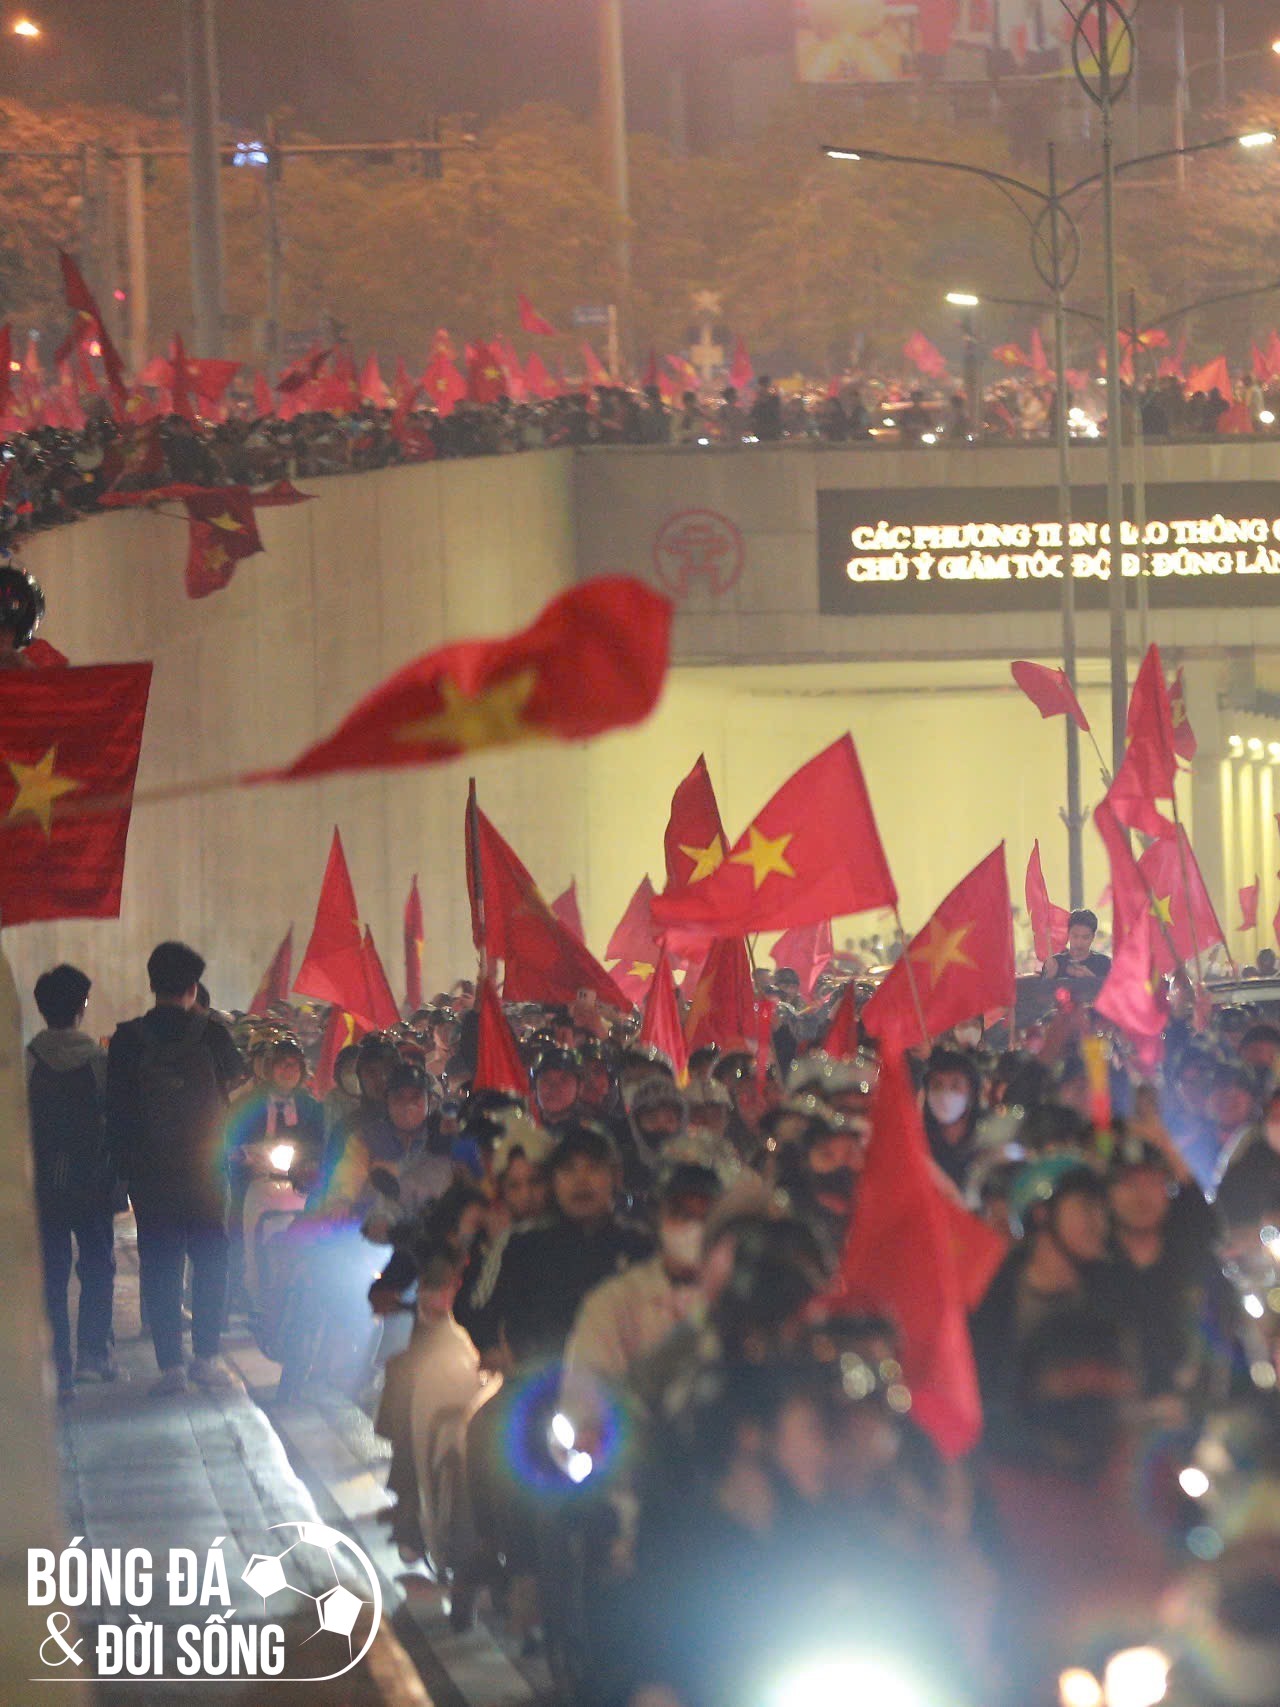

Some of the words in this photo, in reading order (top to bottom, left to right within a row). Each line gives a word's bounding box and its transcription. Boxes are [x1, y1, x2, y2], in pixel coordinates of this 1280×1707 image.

[851, 520, 911, 550] CÁC
[912, 522, 1032, 549] PHƯƠNG
[1169, 513, 1269, 544] THÔNG
[847, 552, 909, 582] CHÚ
